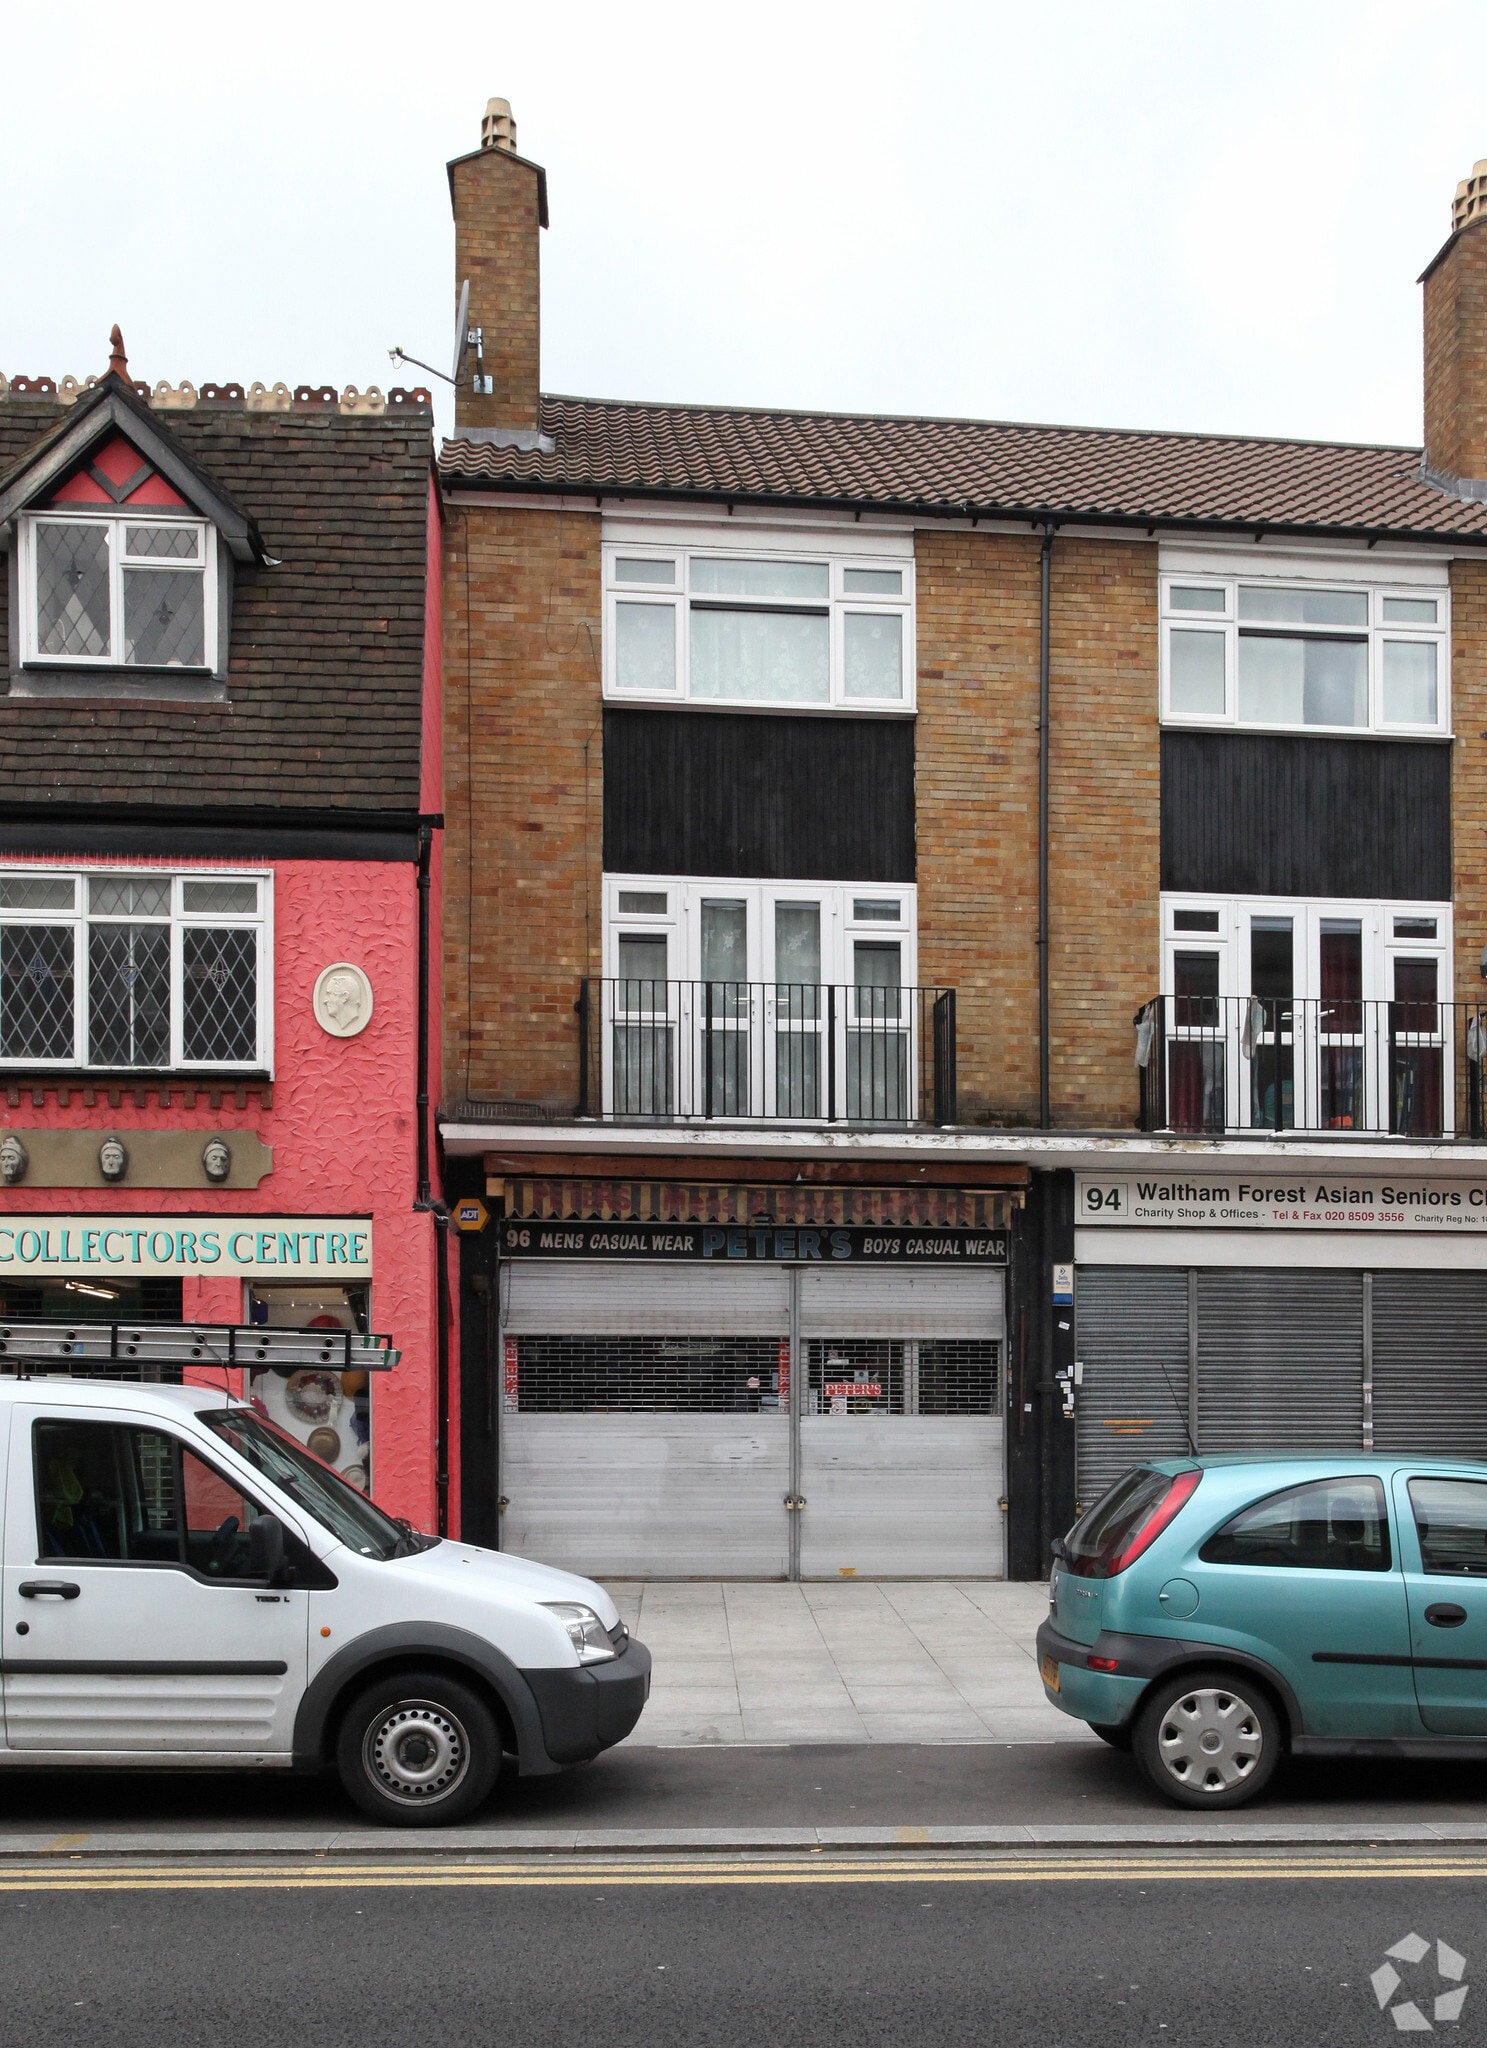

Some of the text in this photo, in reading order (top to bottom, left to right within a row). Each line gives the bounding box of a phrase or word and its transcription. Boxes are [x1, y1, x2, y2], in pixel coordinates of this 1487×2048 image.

[1086, 1187, 1122, 1211] 94
[1137, 1183, 1230, 1201] Waltham
[1238, 1185, 1306, 1202] Forest
[1315, 1186, 1373, 1204] Asian
[1381, 1187, 1462, 1206] Seniors
[460, 1208, 479, 1219] ADT
[1134, 1208, 1174, 1219] Charity
[1177, 1208, 1206, 1219] Shop
[1209, 1209, 1217, 1218] &
[1220, 1209, 1259, 1219] Offices
[1272, 1210, 1288, 1220] Tel
[1291, 1211, 1300, 1220] &
[1303, 1211, 1321, 1220] Fax
[1325, 1211, 1345, 1221] 020
[1348, 1212, 1375, 1221] 8509
[1378, 1212, 1404, 1222] 3556
[1414, 1214, 1444, 1224] Charity
[1446, 1215, 1463, 1224] Reg
[1465, 1215, 1479, 1223] No:
[0, 1229, 368, 1264] COLLECTORS CENTRE
[506, 1228, 1006, 1259] 96 MENS CASUAL WEAR PETER'S BOYS CASUAL WEAR
[824, 1383, 882, 1395] PETER'S
